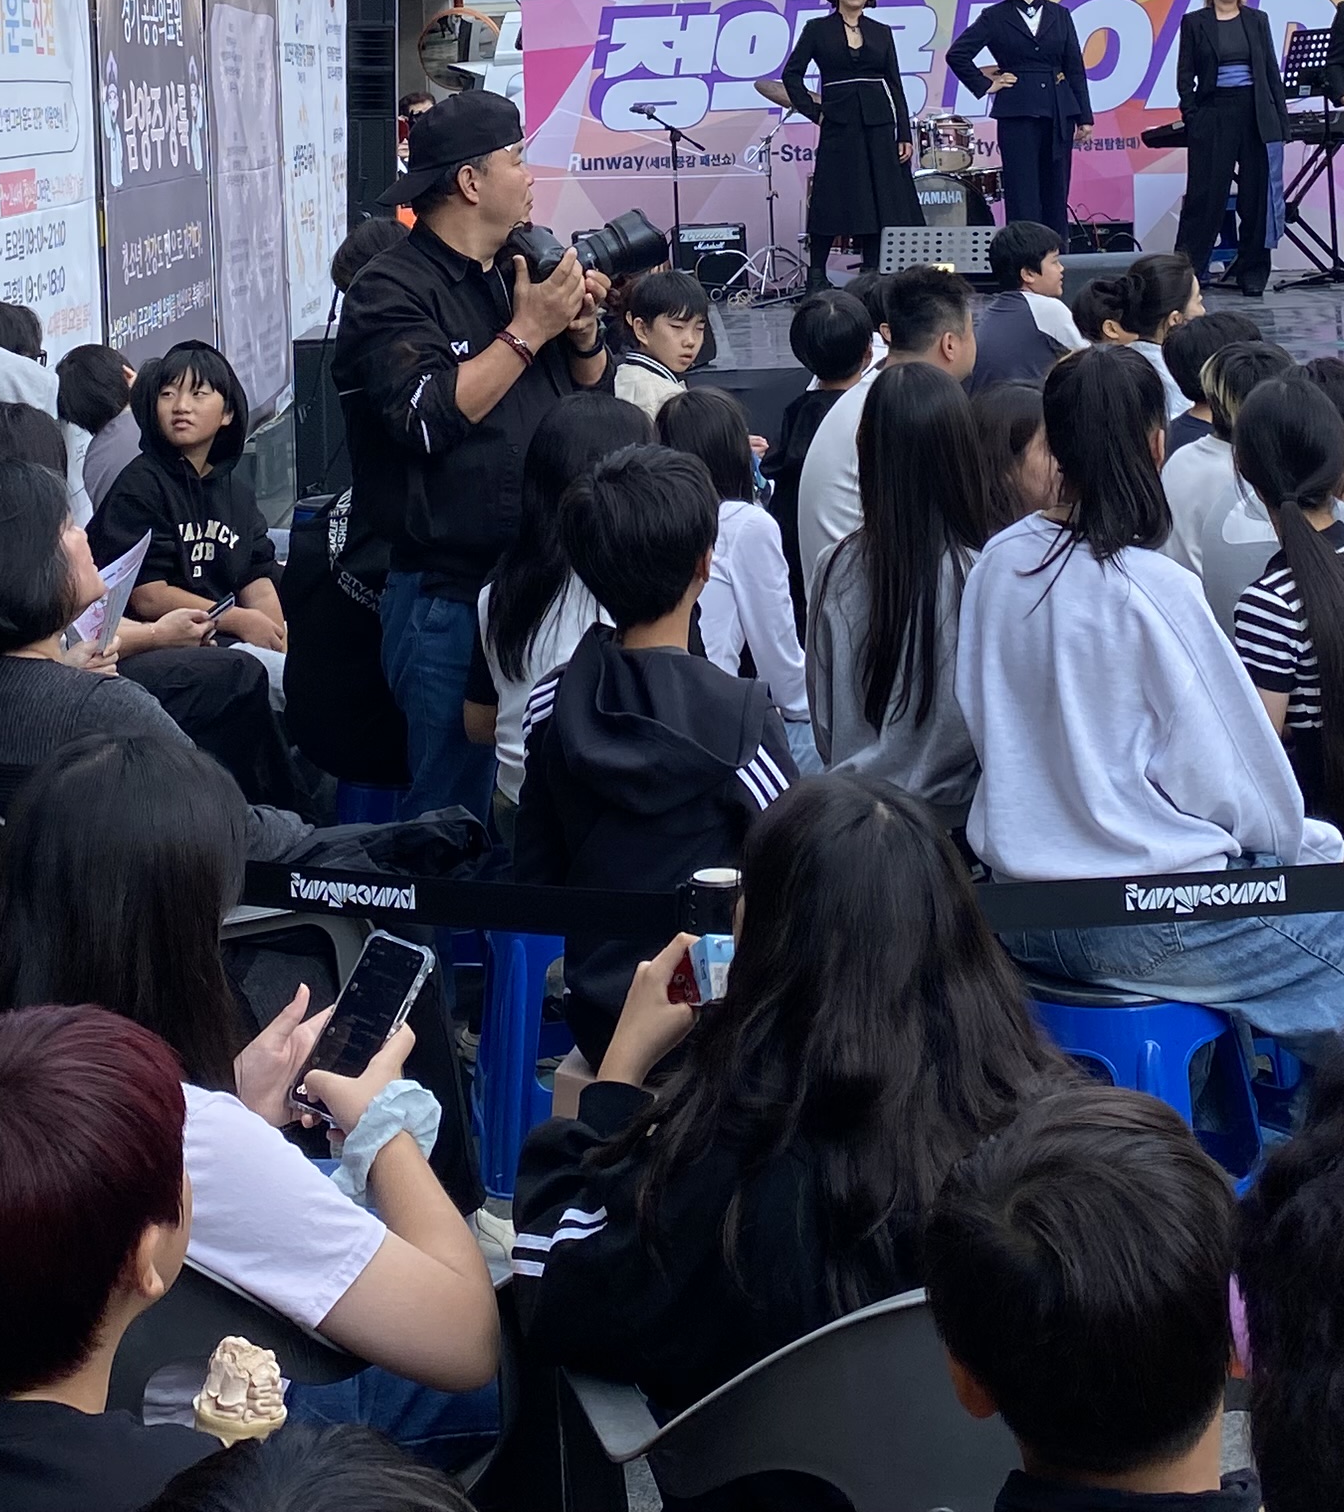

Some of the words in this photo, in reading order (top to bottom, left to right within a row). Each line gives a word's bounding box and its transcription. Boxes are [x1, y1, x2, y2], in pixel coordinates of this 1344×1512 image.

[122, 79, 166, 174] 남양주
[165, 80, 191, 169] 상륙
[743, 144, 820, 165] On-Sta
[917, 190, 964, 206] YAMAHA
[121, 237, 143, 286] 청소년
